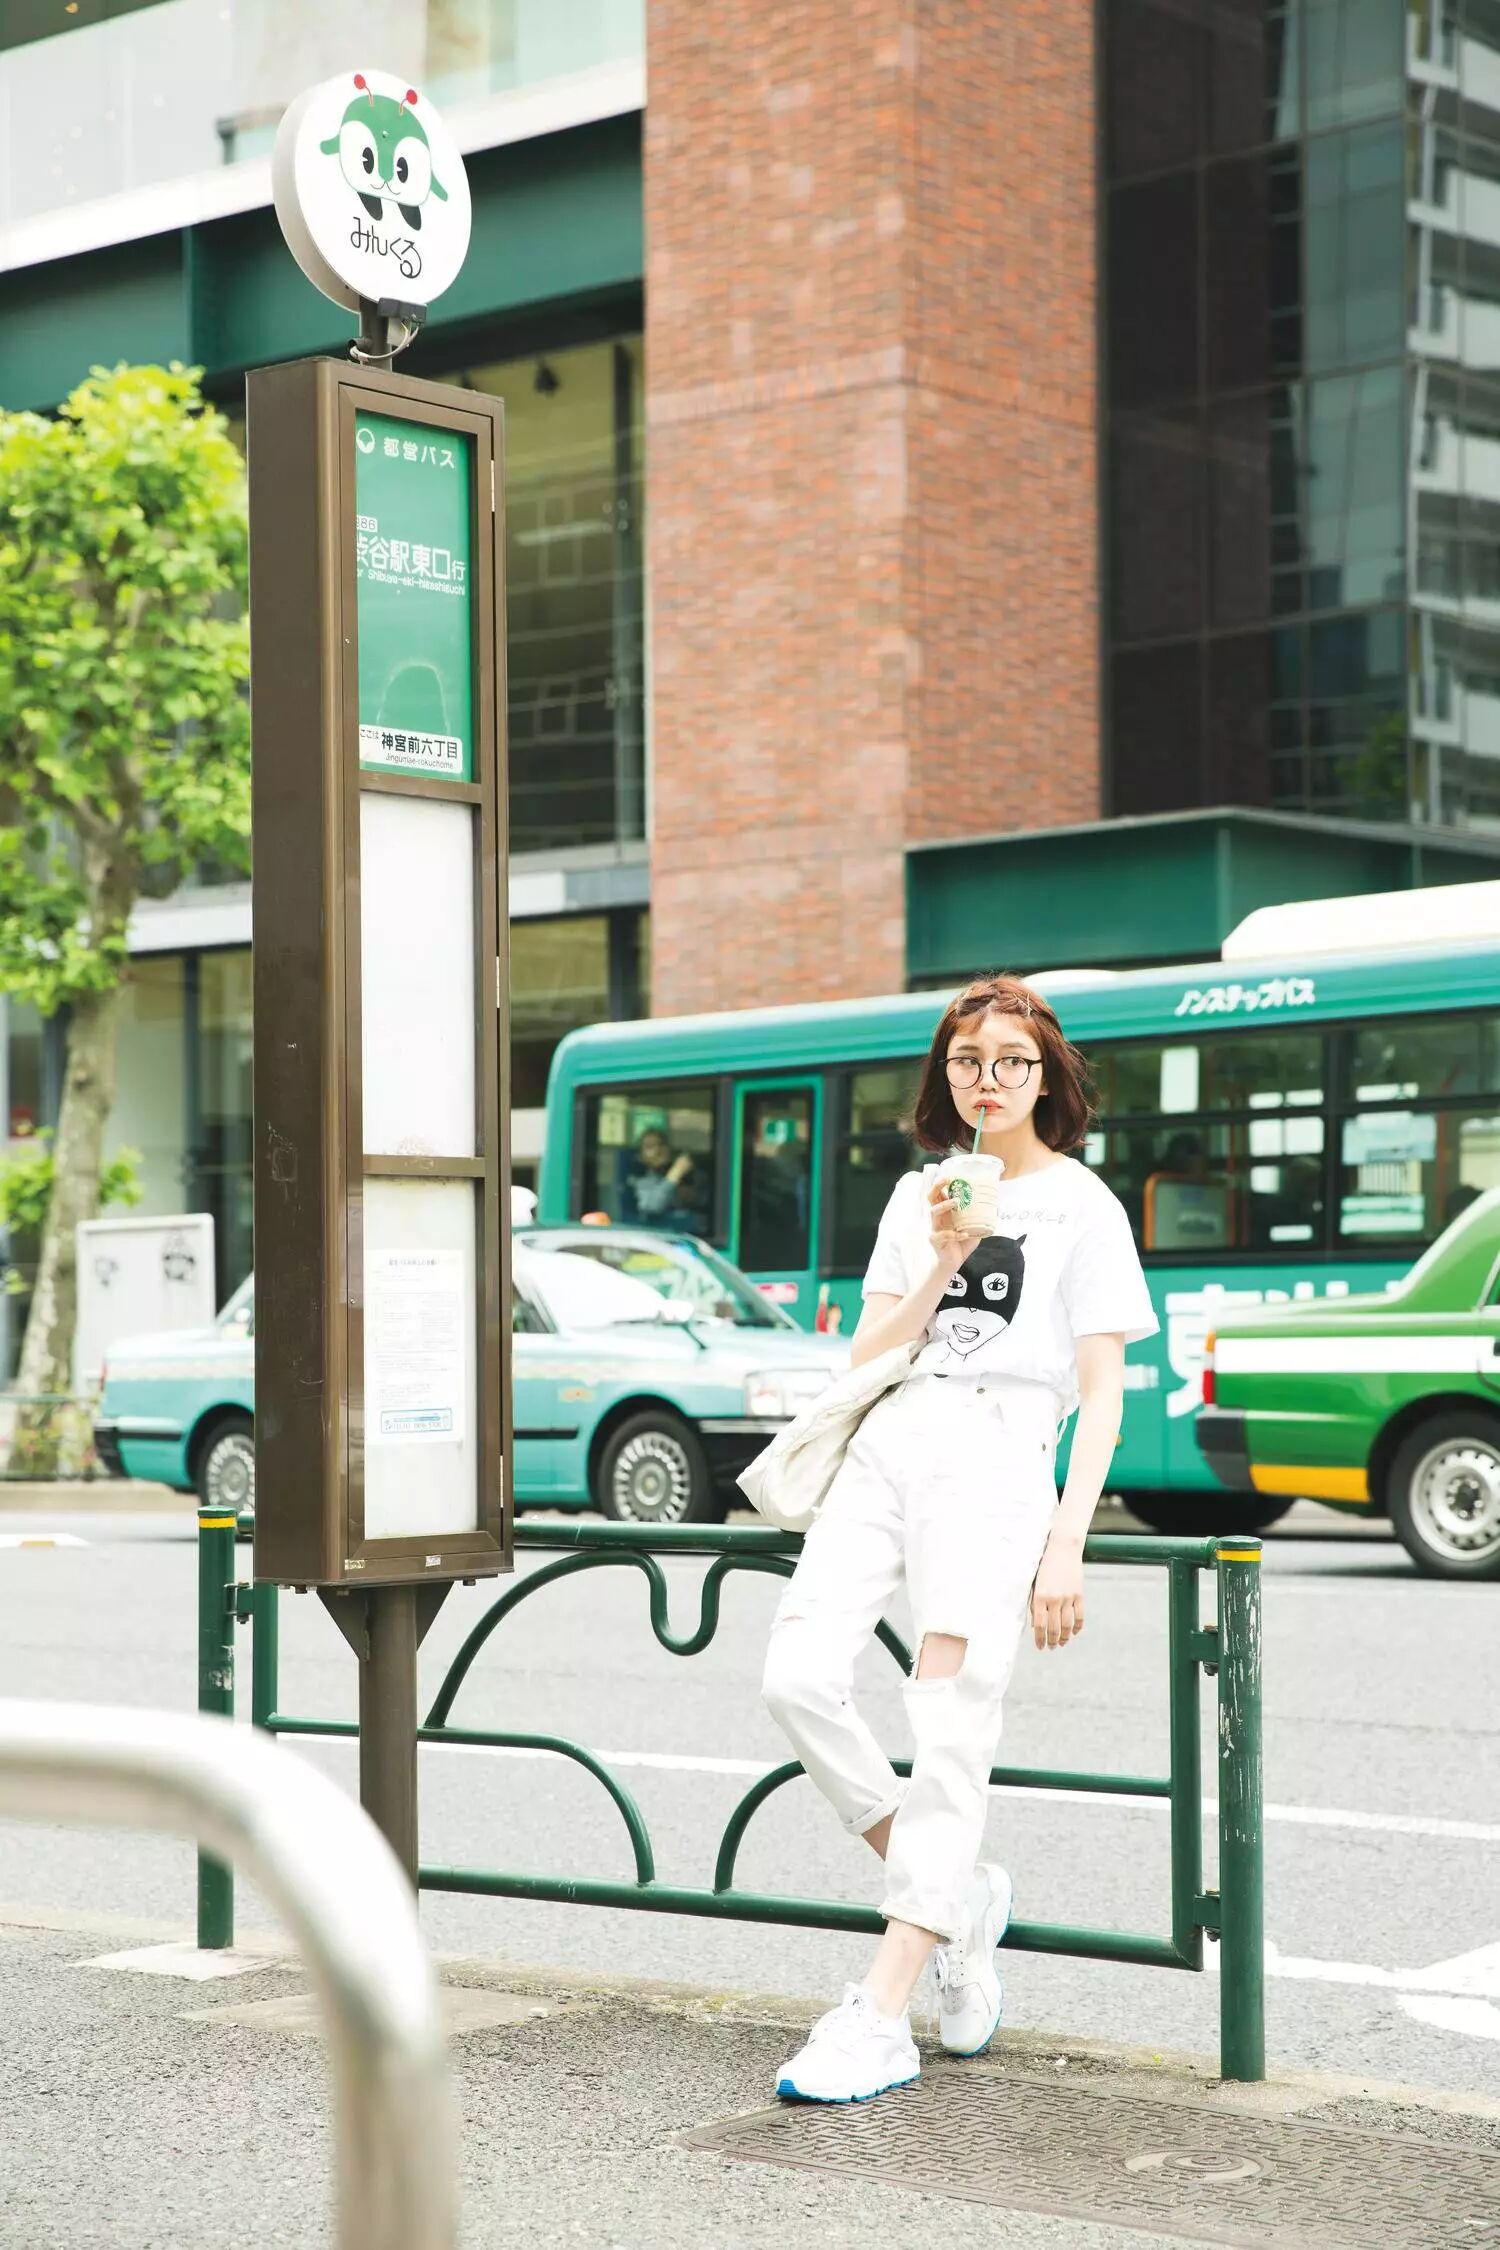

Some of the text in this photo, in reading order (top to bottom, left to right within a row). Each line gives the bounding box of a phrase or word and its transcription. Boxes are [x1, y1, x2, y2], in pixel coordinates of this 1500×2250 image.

[350, 216, 422, 279] みんくる
[383, 436, 455, 469] 都営バス
[381, 732, 458, 759] 神宮前六丁目
[1174, 978, 1316, 1017] ノンステップバス
